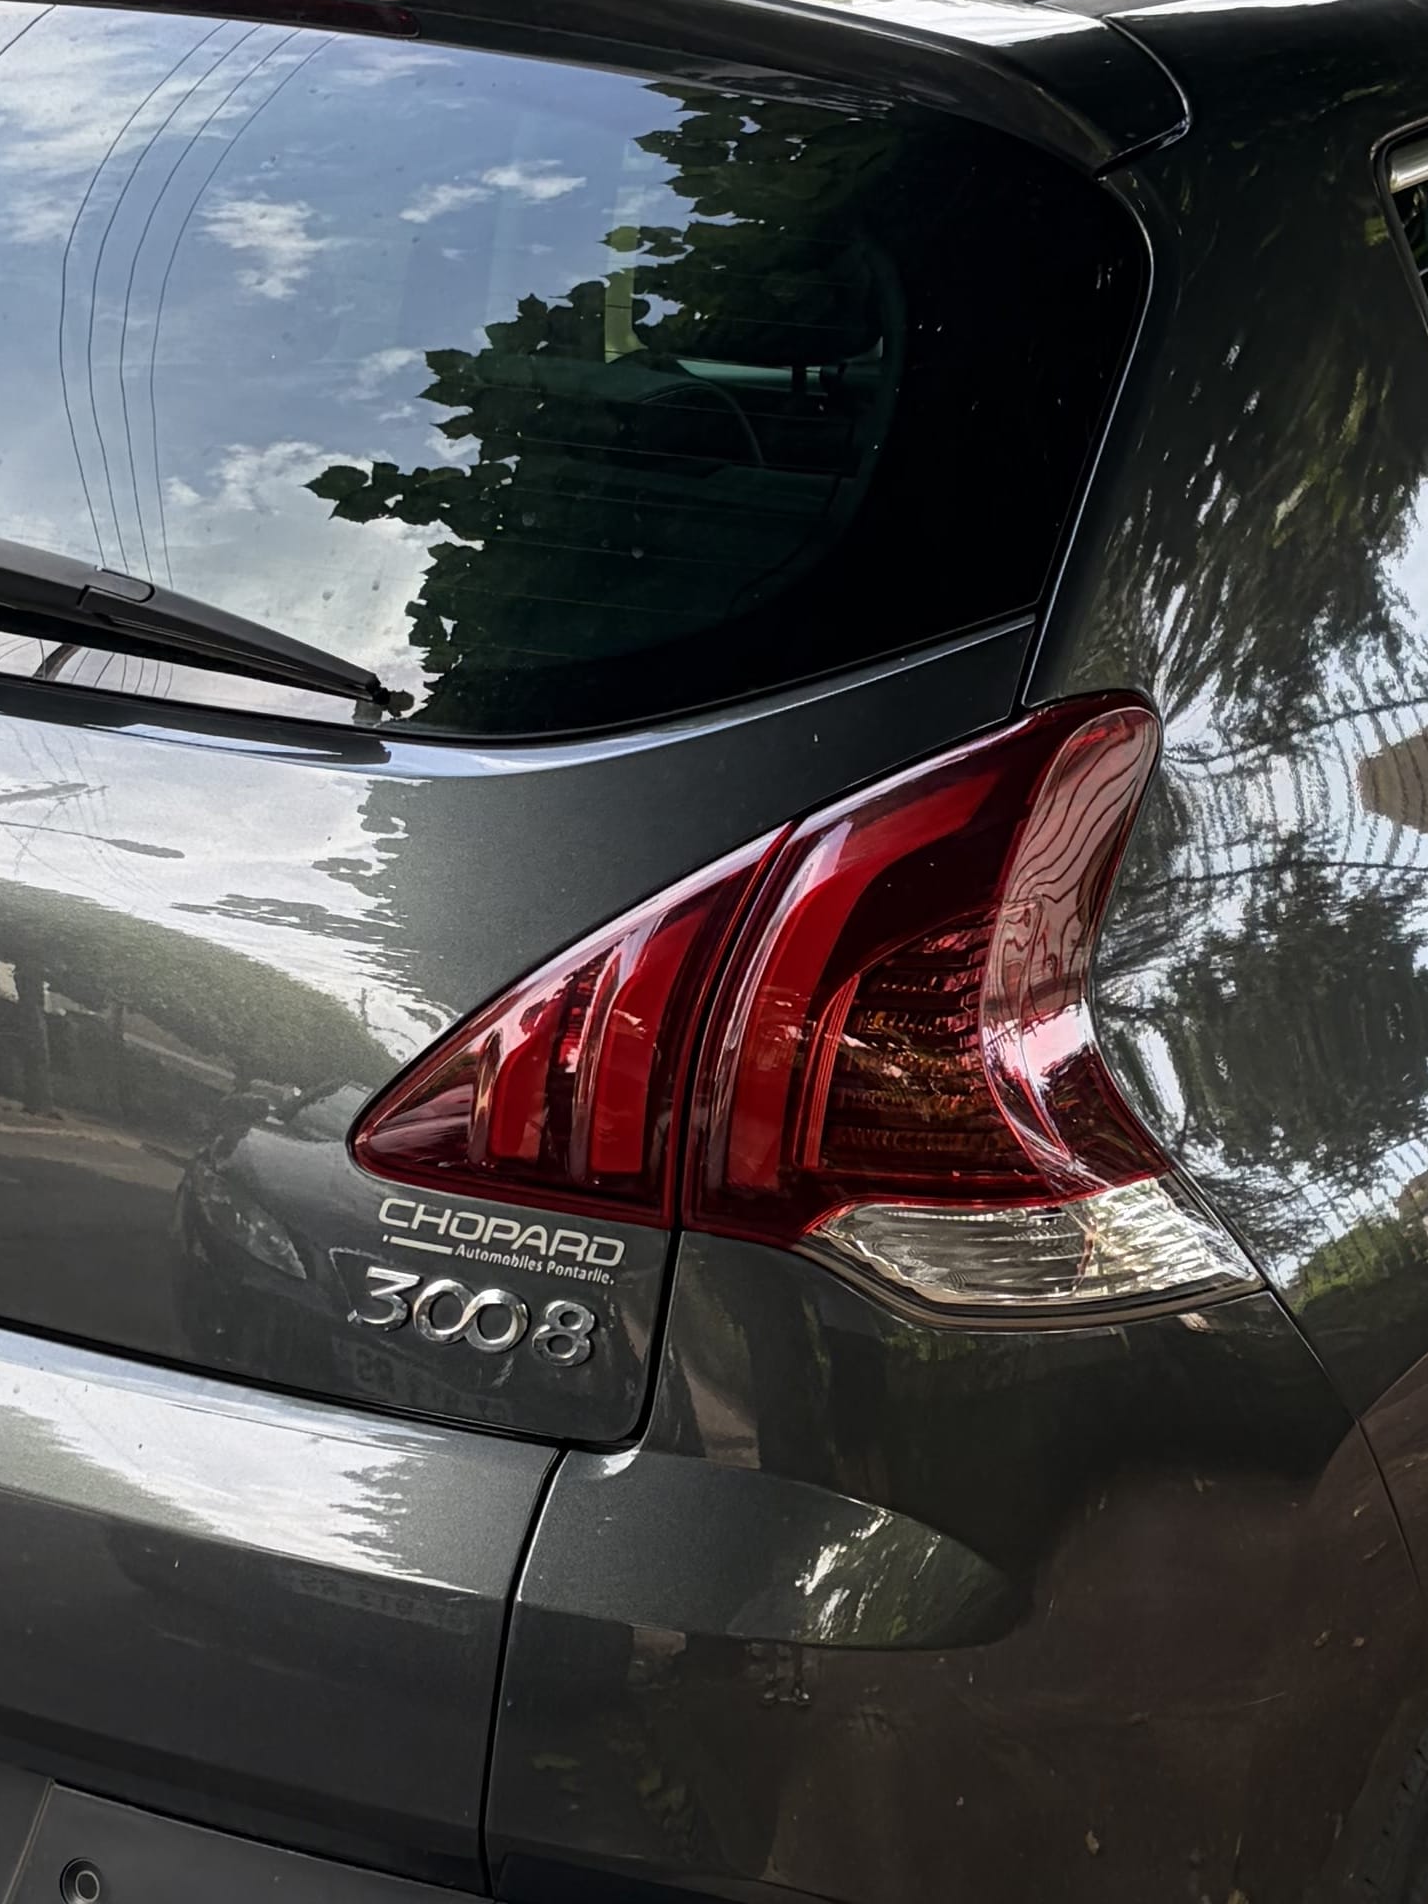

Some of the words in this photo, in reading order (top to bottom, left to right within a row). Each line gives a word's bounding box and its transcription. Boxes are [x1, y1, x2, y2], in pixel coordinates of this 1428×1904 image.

[378, 1197, 626, 1268] CHOPARD
[454, 1242, 544, 1273] Automobiles
[546, 1259, 615, 1286] Pontarlie
[347, 1266, 597, 1366] 3008
